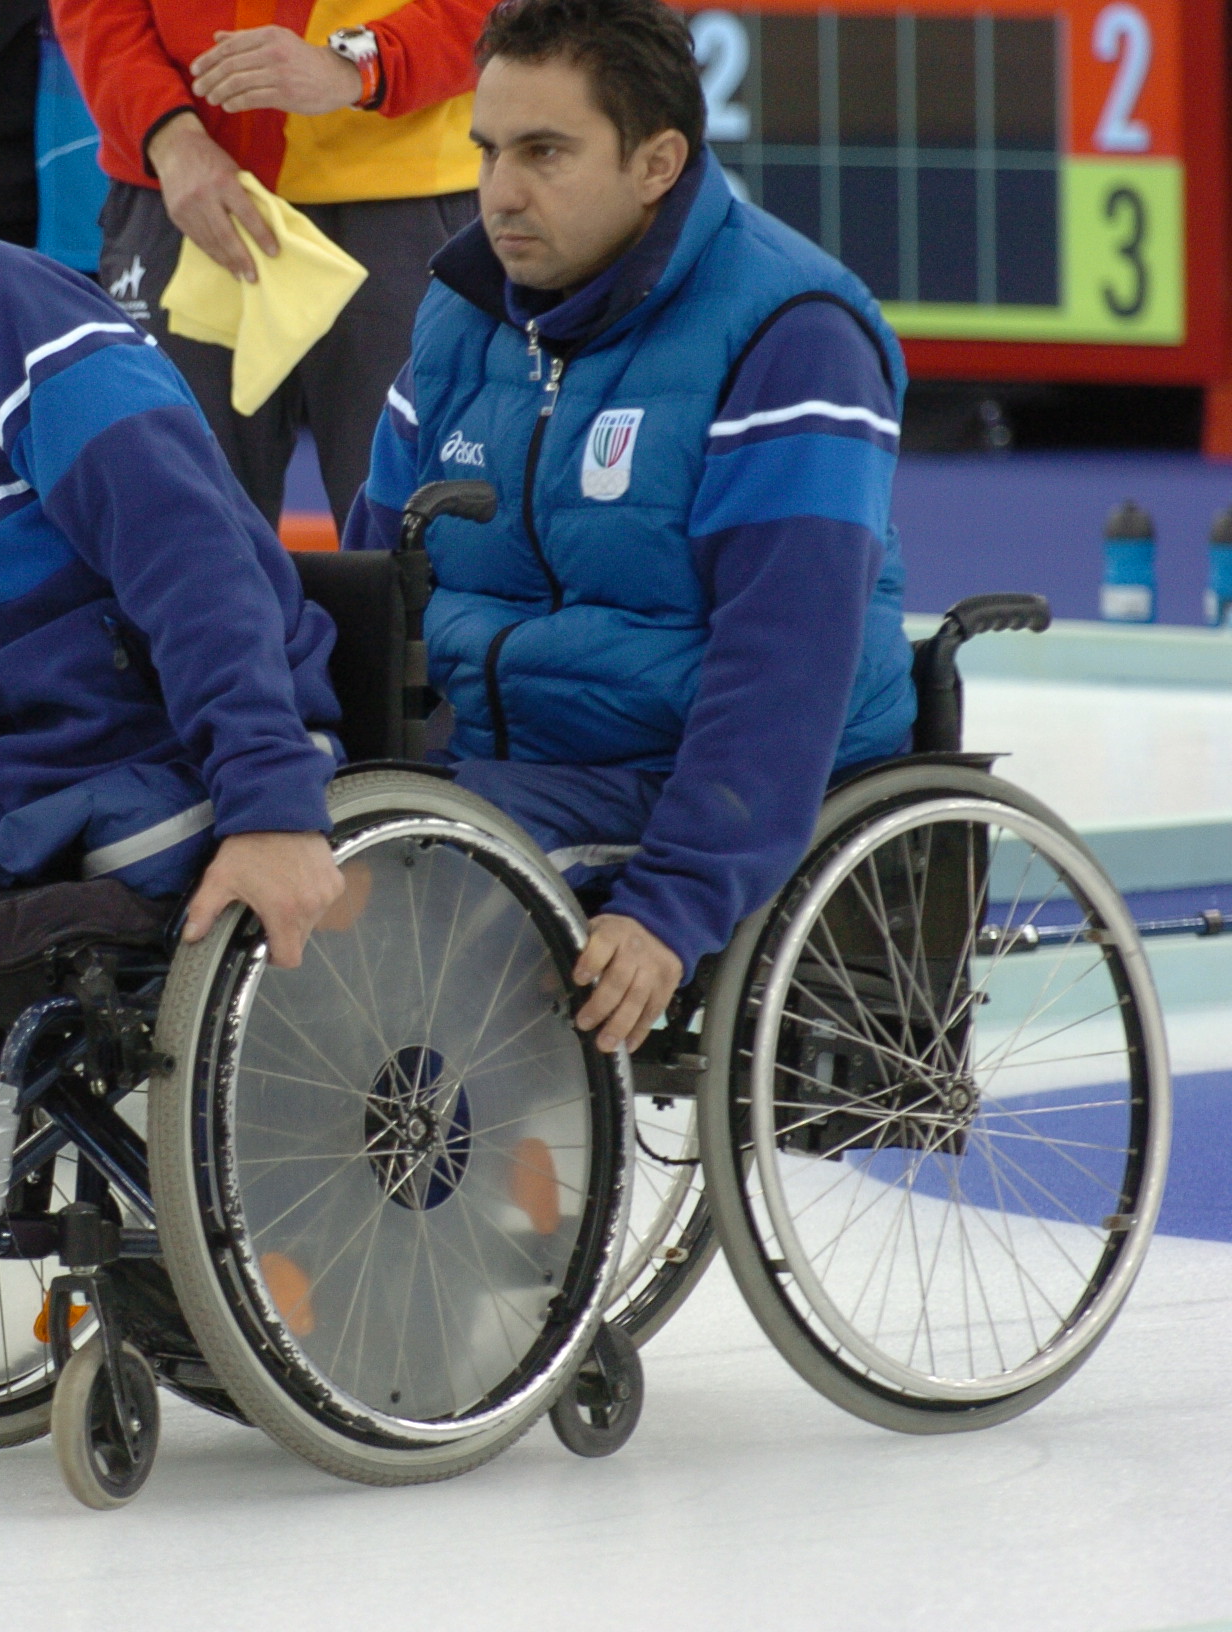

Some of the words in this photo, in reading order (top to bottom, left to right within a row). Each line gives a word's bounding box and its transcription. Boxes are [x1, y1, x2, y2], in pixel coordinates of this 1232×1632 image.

[690, 10, 751, 141] 2
[1091, 3, 1152, 152] 2
[1100, 185, 1147, 319] 3
